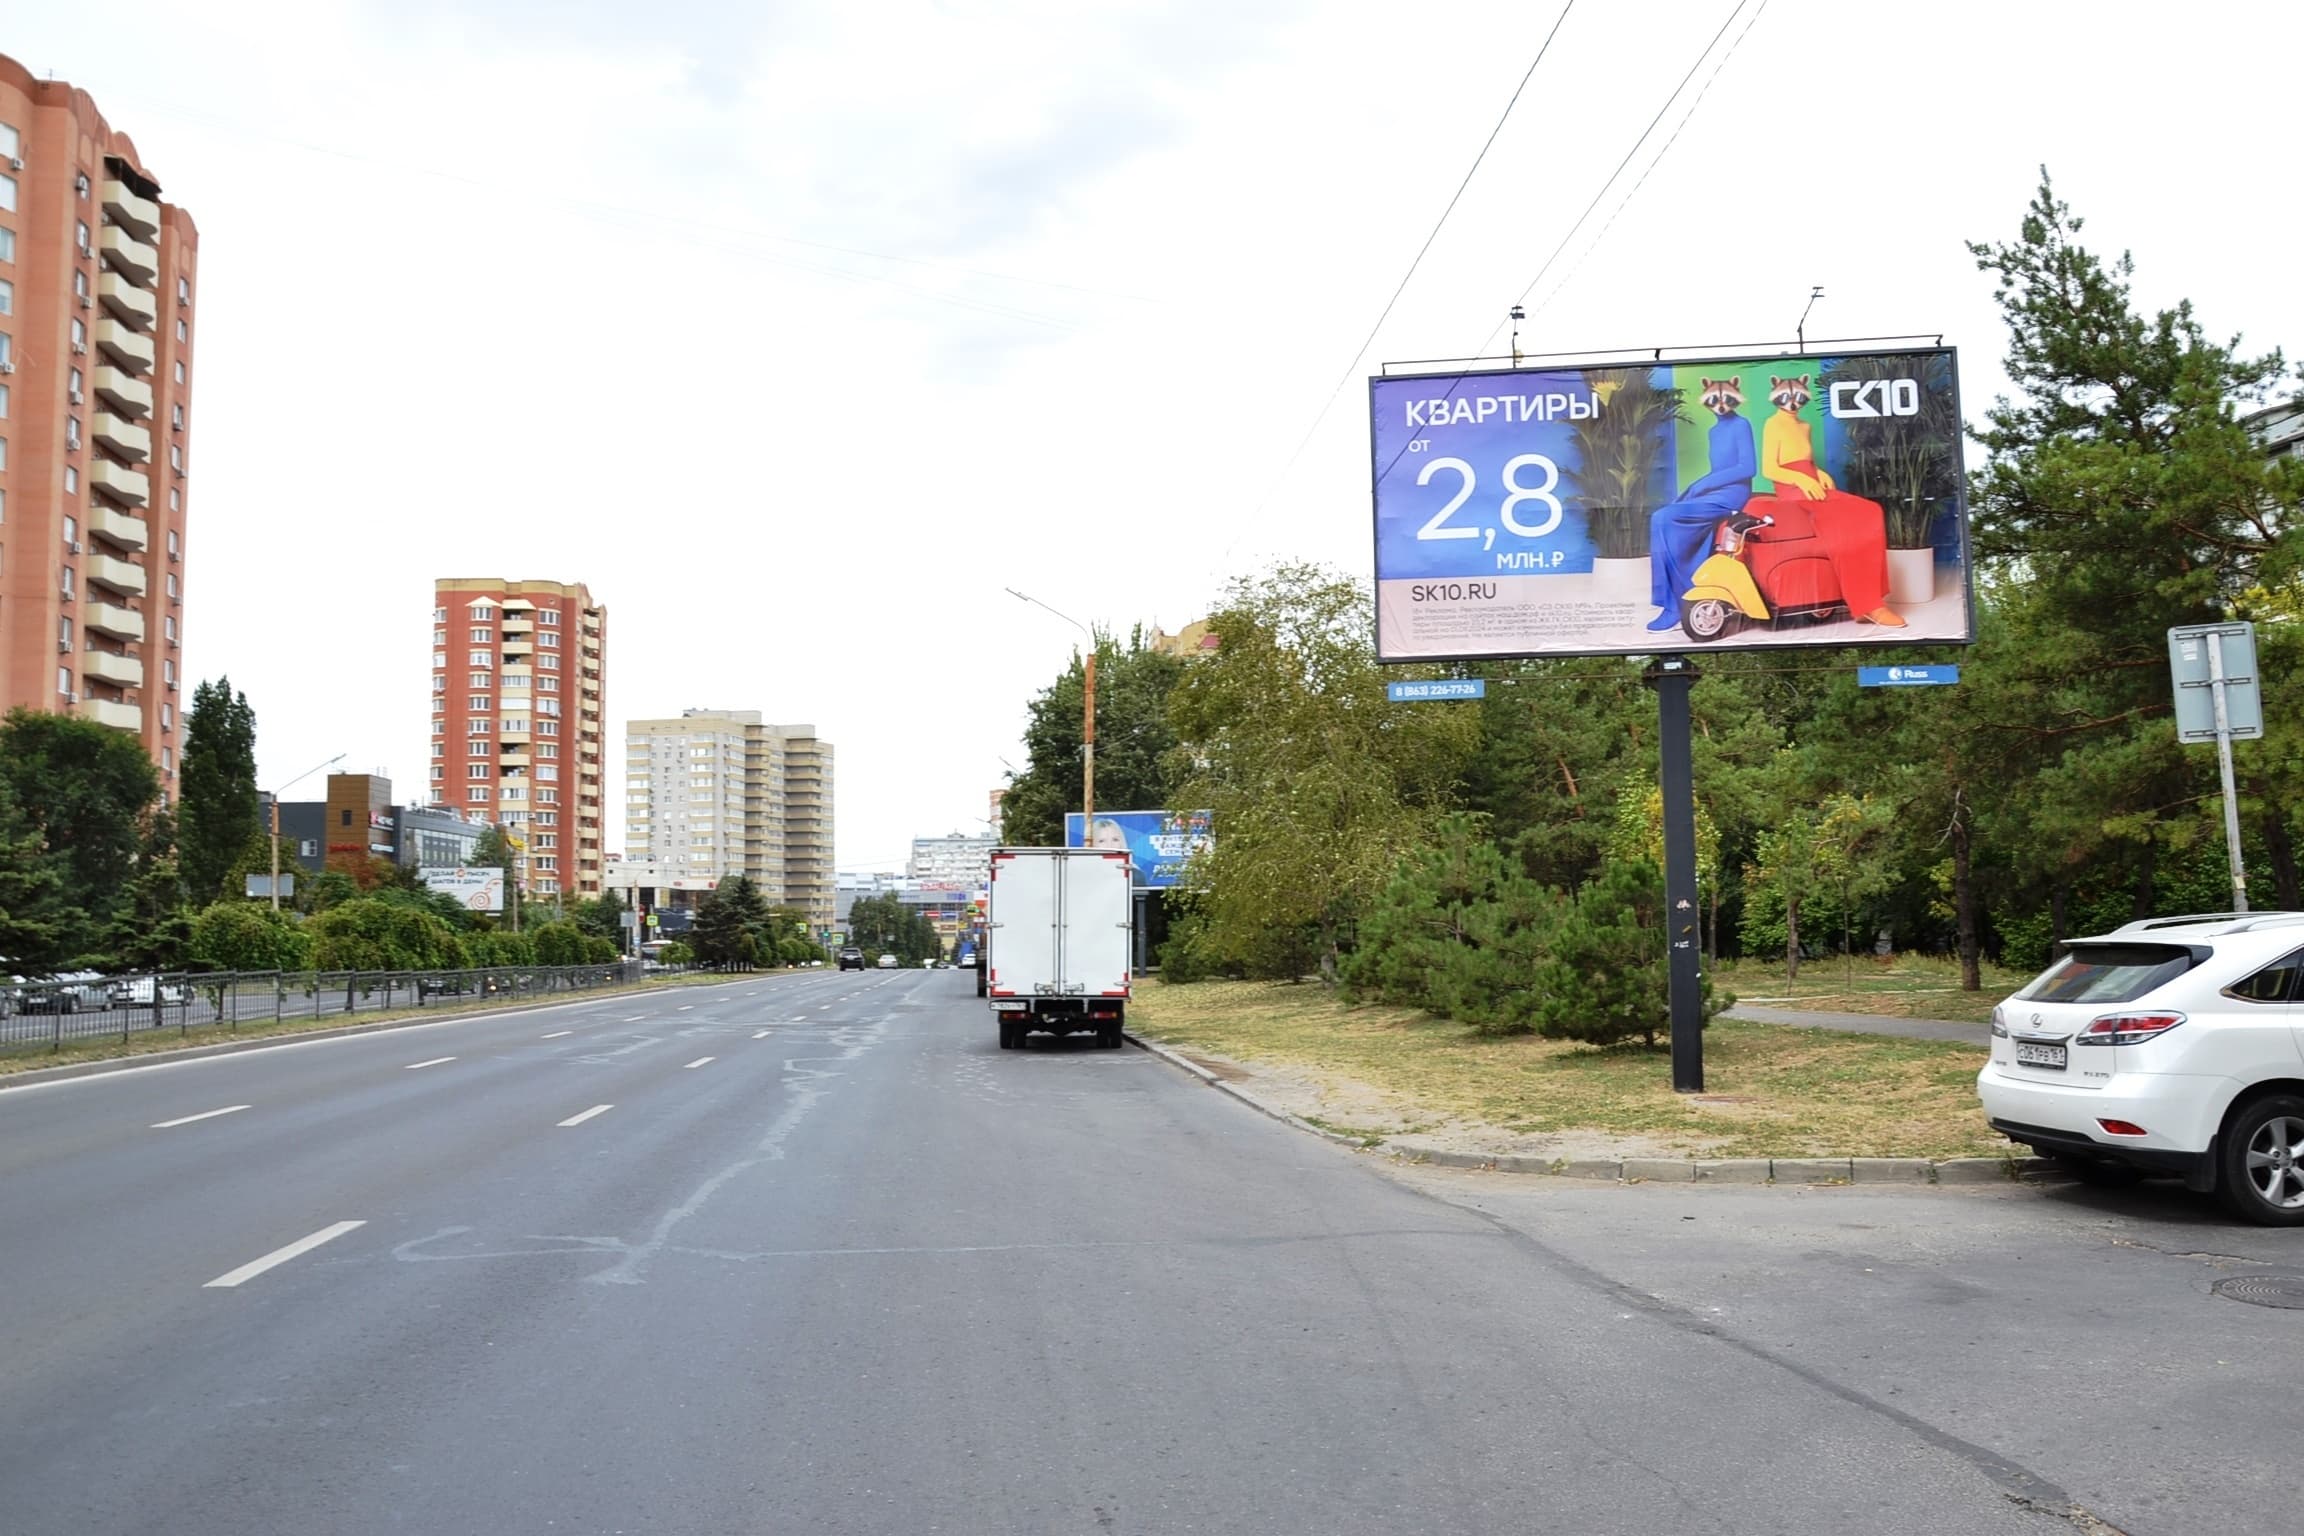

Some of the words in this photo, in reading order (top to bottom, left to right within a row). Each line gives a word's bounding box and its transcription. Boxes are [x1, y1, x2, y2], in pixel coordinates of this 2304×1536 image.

[1405, 392, 1599, 427] КВАРТИРЫ
[1829, 378, 1919, 418] СК10
[1416, 453, 1563, 551] 2,8
[1412, 582, 1497, 602] SK10.RU
[1904, 669, 1929, 679] Russ
[1395, 687, 1403, 696] 8
[1404, 685, 1429, 697] (863)
[1430, 684, 1476, 695] 226-77-26
